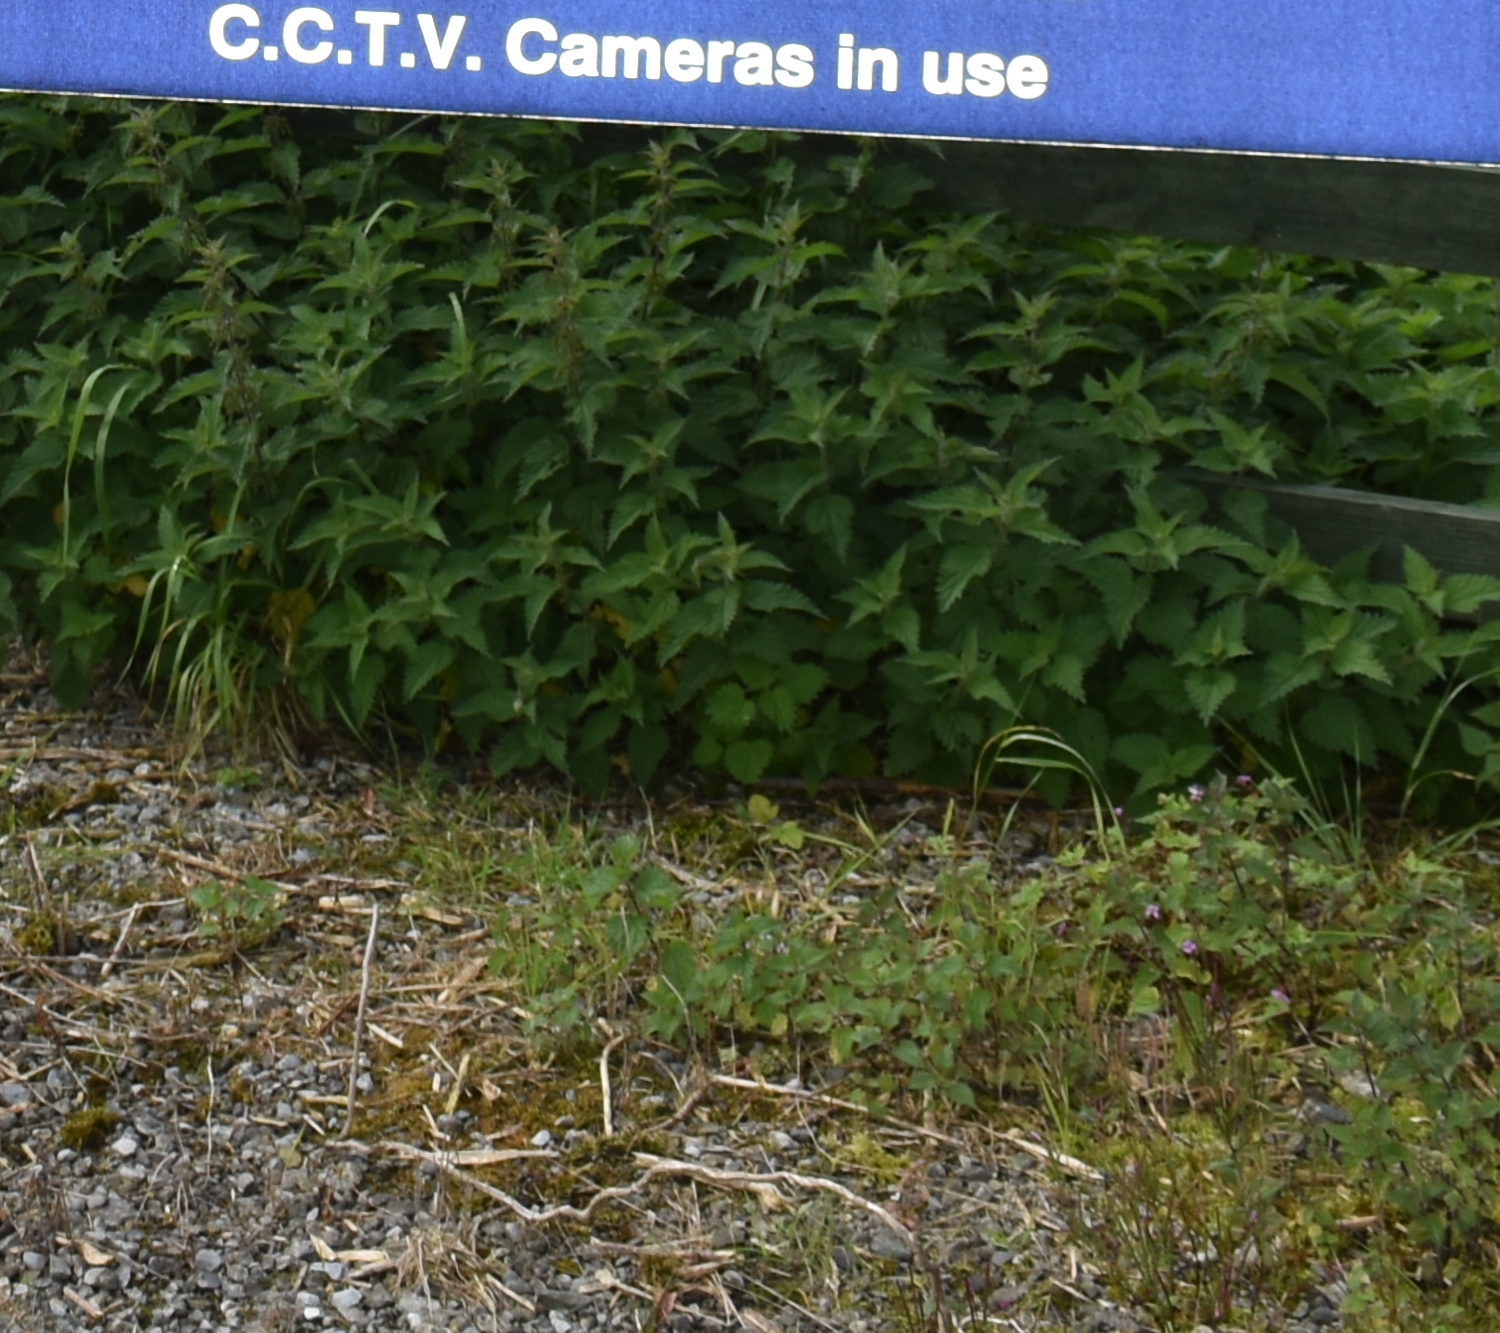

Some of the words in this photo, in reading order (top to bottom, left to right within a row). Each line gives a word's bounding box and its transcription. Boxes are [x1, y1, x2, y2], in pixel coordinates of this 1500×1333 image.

[209, 4, 481, 71] C.C.T.V.
[506, 18, 814, 88] Cameras
[838, 34, 898, 91] in
[923, 51, 1048, 99] use
